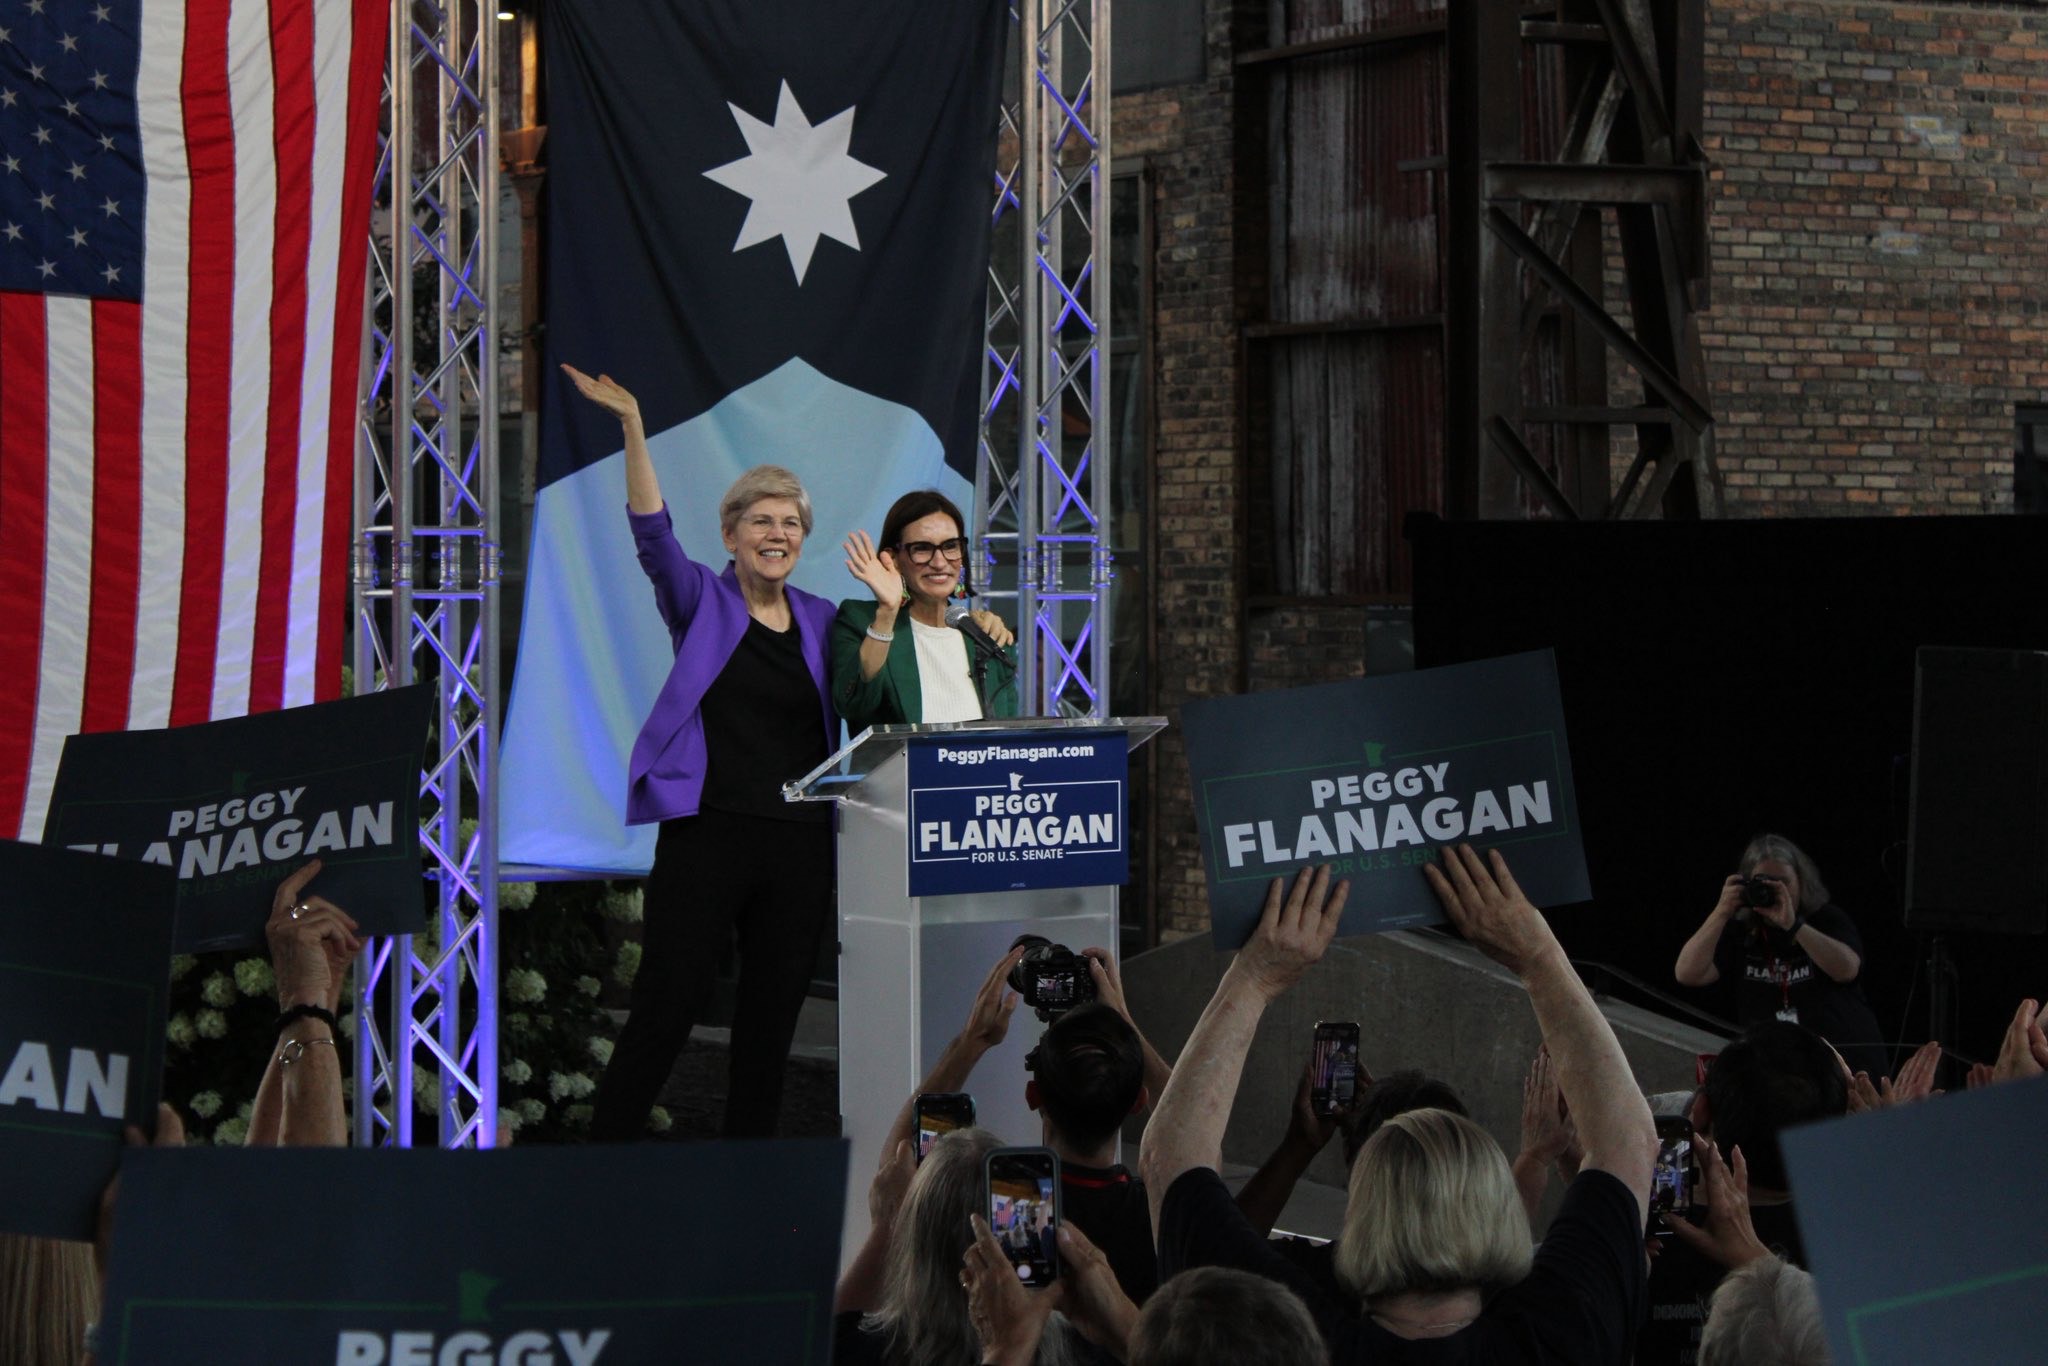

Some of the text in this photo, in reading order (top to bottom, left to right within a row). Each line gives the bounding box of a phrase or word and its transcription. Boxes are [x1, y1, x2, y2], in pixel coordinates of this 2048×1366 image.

[938, 745, 1094, 765] PeggyFlanagan.com
[1310, 762, 1449, 809] PEGGY
[167, 786, 306, 837] PEGGY
[975, 792, 1058, 816] PEGGY
[920, 813, 1113, 852] FLANAGAN
[1223, 780, 1552, 868] FLANAGAN
[971, 849, 1064, 863] FOR U.S. SENATE
[1401, 847, 1439, 865] SEN
[336, 1330, 612, 1366] PEGGY
